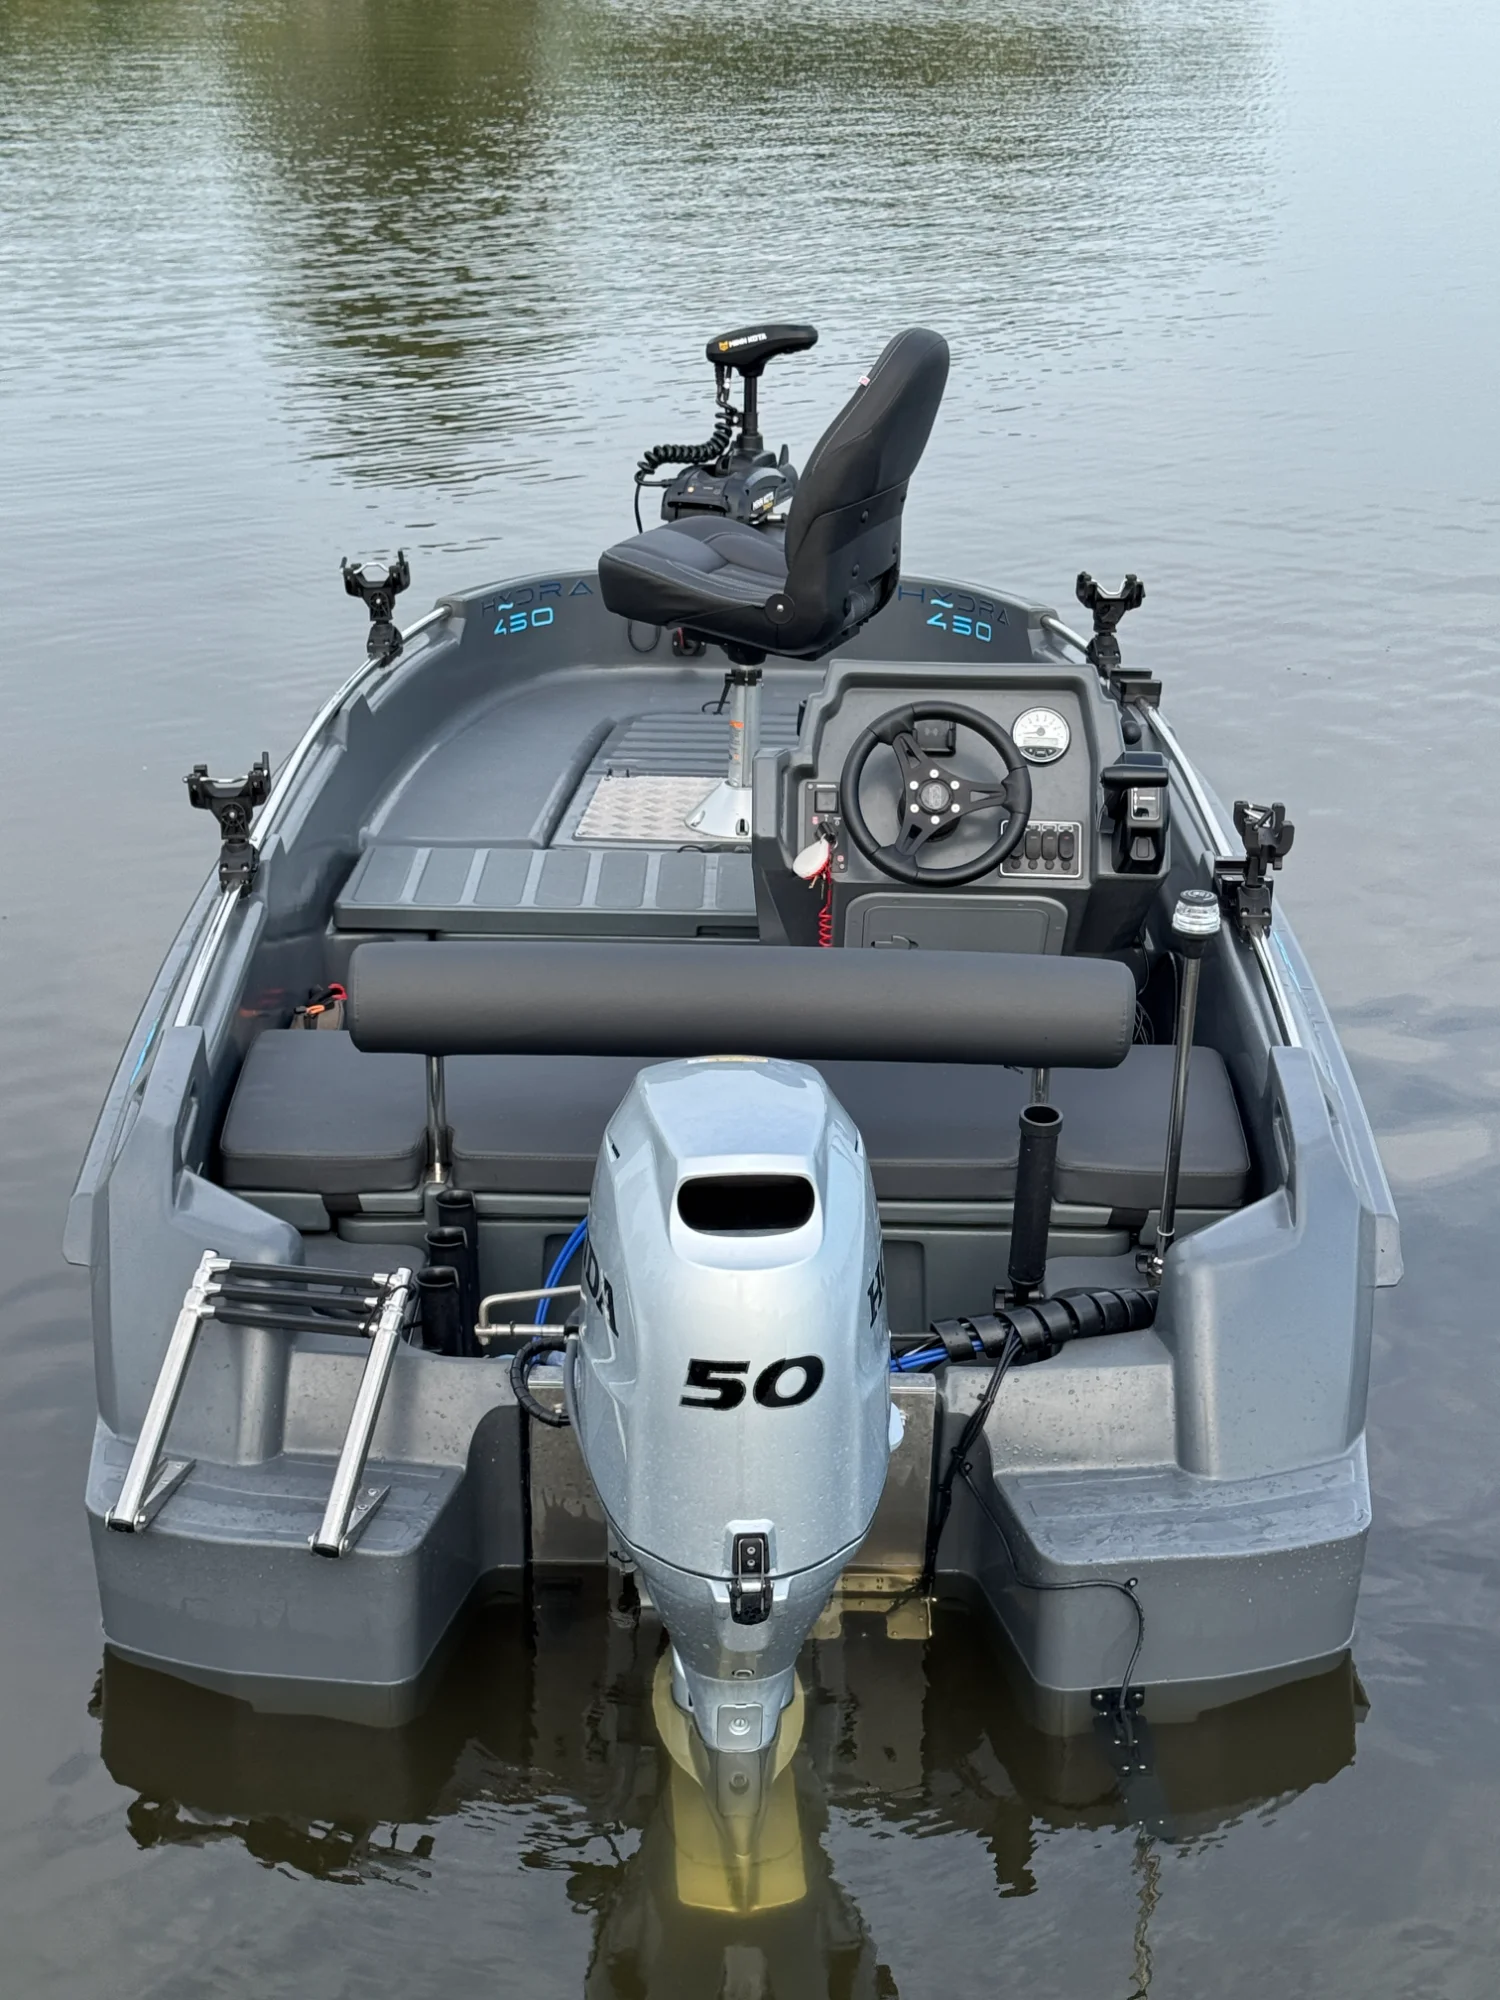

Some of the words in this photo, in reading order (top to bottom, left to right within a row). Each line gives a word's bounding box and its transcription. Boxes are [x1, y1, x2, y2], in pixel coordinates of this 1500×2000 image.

[481, 579, 594, 617] HYDRA
[898, 584, 1010, 626] HYDRA
[494, 607, 554, 635] 450
[926, 612, 991, 642] 450
[678, 1353, 825, 1412] 50
